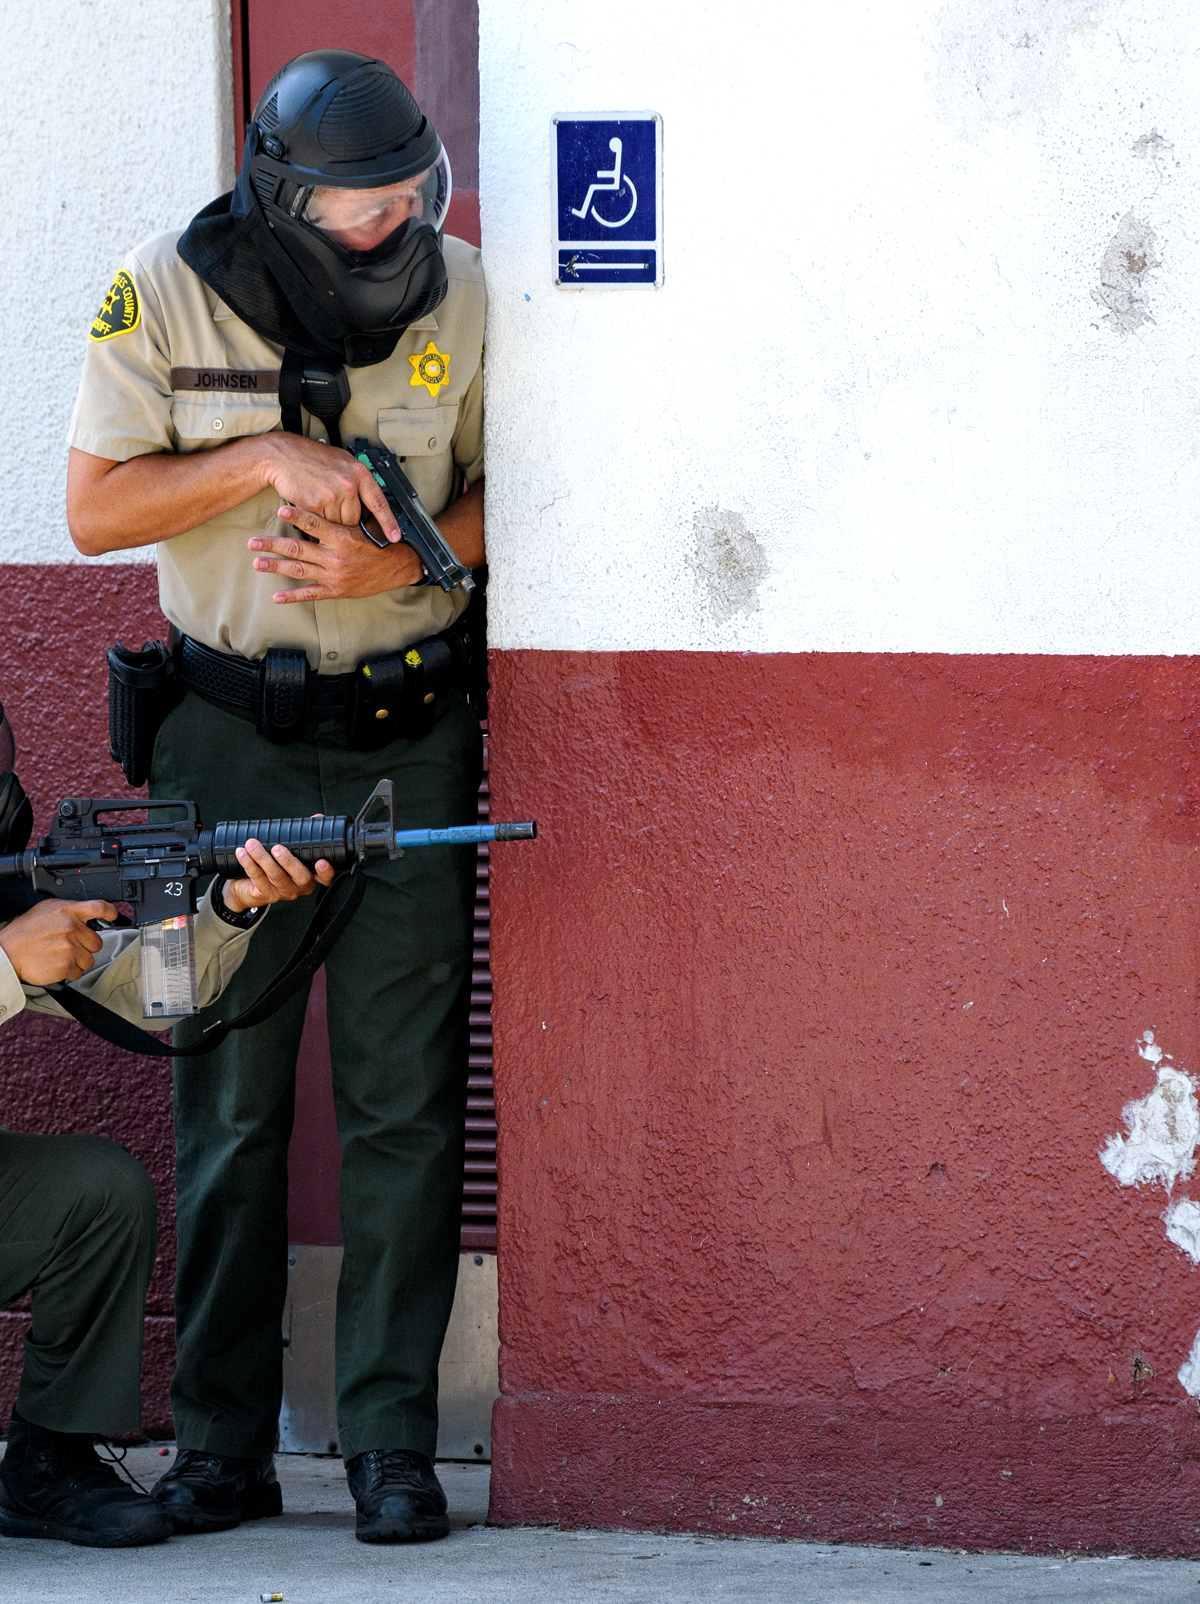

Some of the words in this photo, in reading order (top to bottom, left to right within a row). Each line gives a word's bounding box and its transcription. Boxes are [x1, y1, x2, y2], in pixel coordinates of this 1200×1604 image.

[122, 286, 136, 328] COUNTY
[193, 373, 258, 389] JOHNSEN
[164, 881, 184, 897] 23
